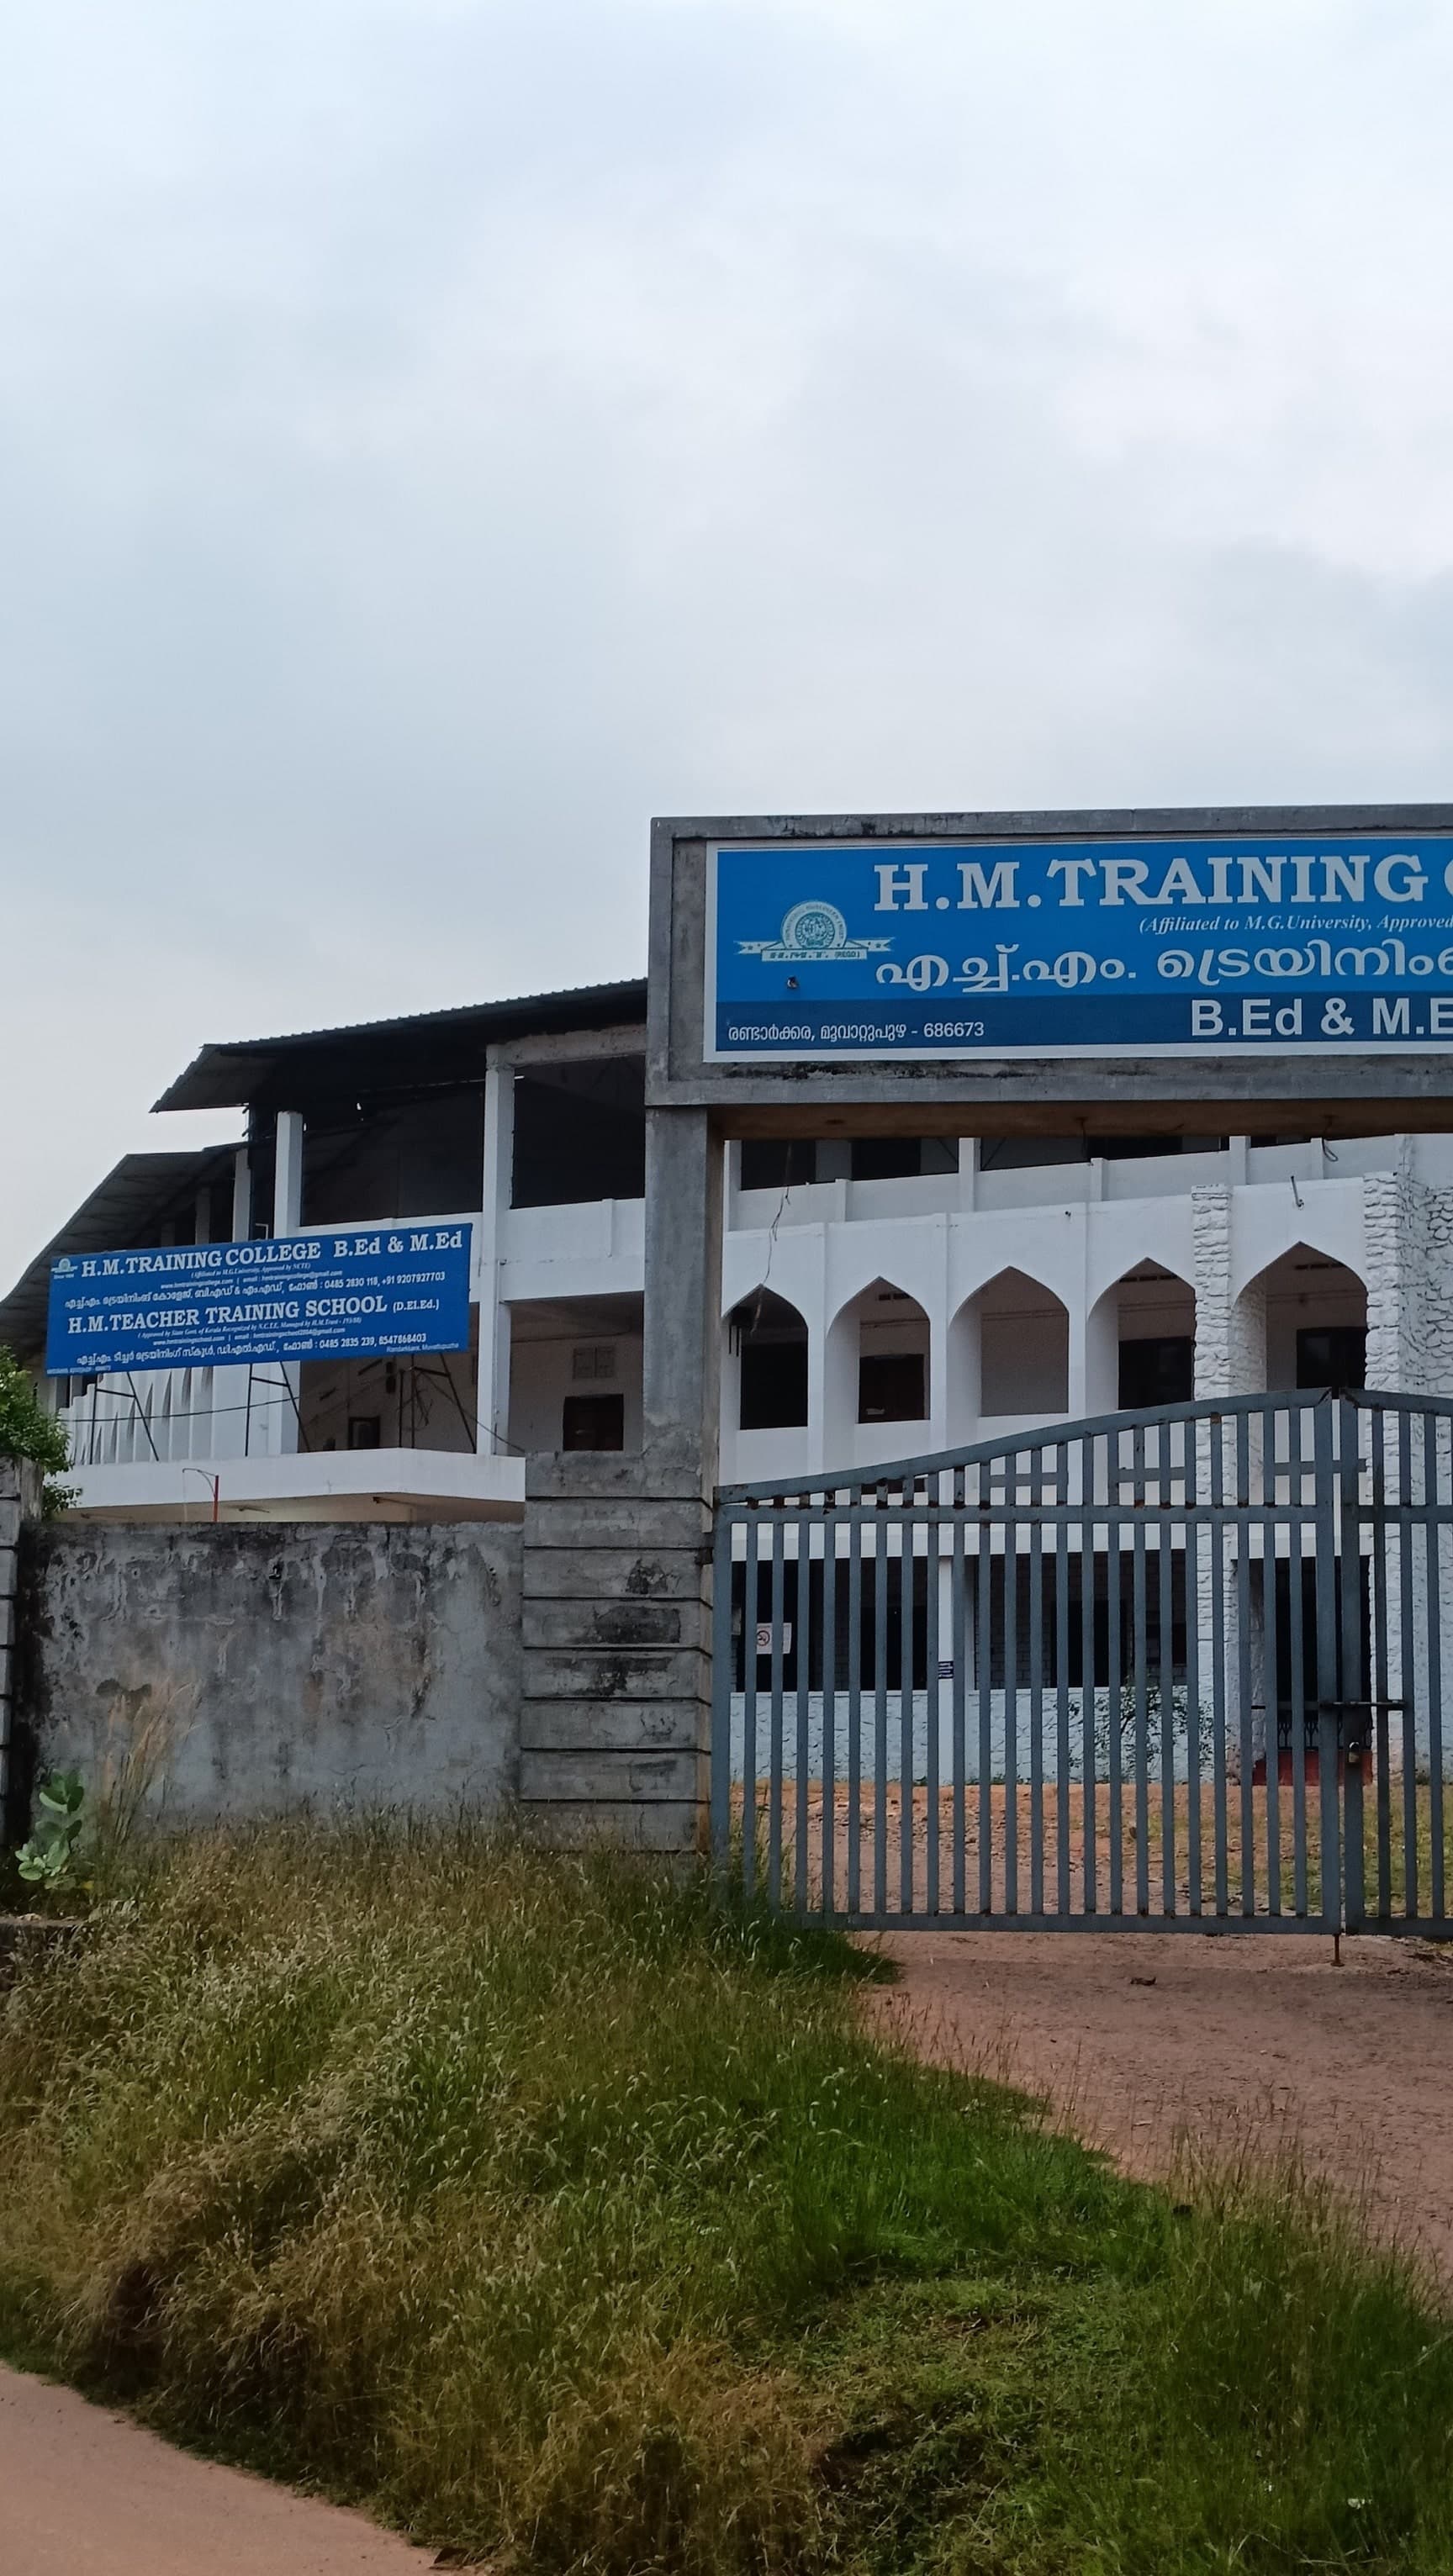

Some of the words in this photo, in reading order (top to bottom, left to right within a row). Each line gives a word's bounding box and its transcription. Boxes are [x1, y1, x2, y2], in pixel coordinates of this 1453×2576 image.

[1139, 916, 1220, 935] (Affiliated
[1223, 918, 1239, 931] to
[1244, 915, 1372, 932] M.G.University,
[1191, 998, 1302, 1037] B.Ed
[1320, 997, 1355, 1036] &
[924, 1022, 985, 1038] 686673
[225, 1242, 321, 1266] COLLEGE
[334, 1237, 381, 1258] B.Ed
[388, 1236, 404, 1254] &
[409, 1231, 462, 1252] M.Ed
[325, 1279, 344, 1290] 0485
[204, 1301, 300, 1324] TRAINING
[305, 1296, 388, 1317] SCHOOL
[320, 1338, 338, 1349] 0485
